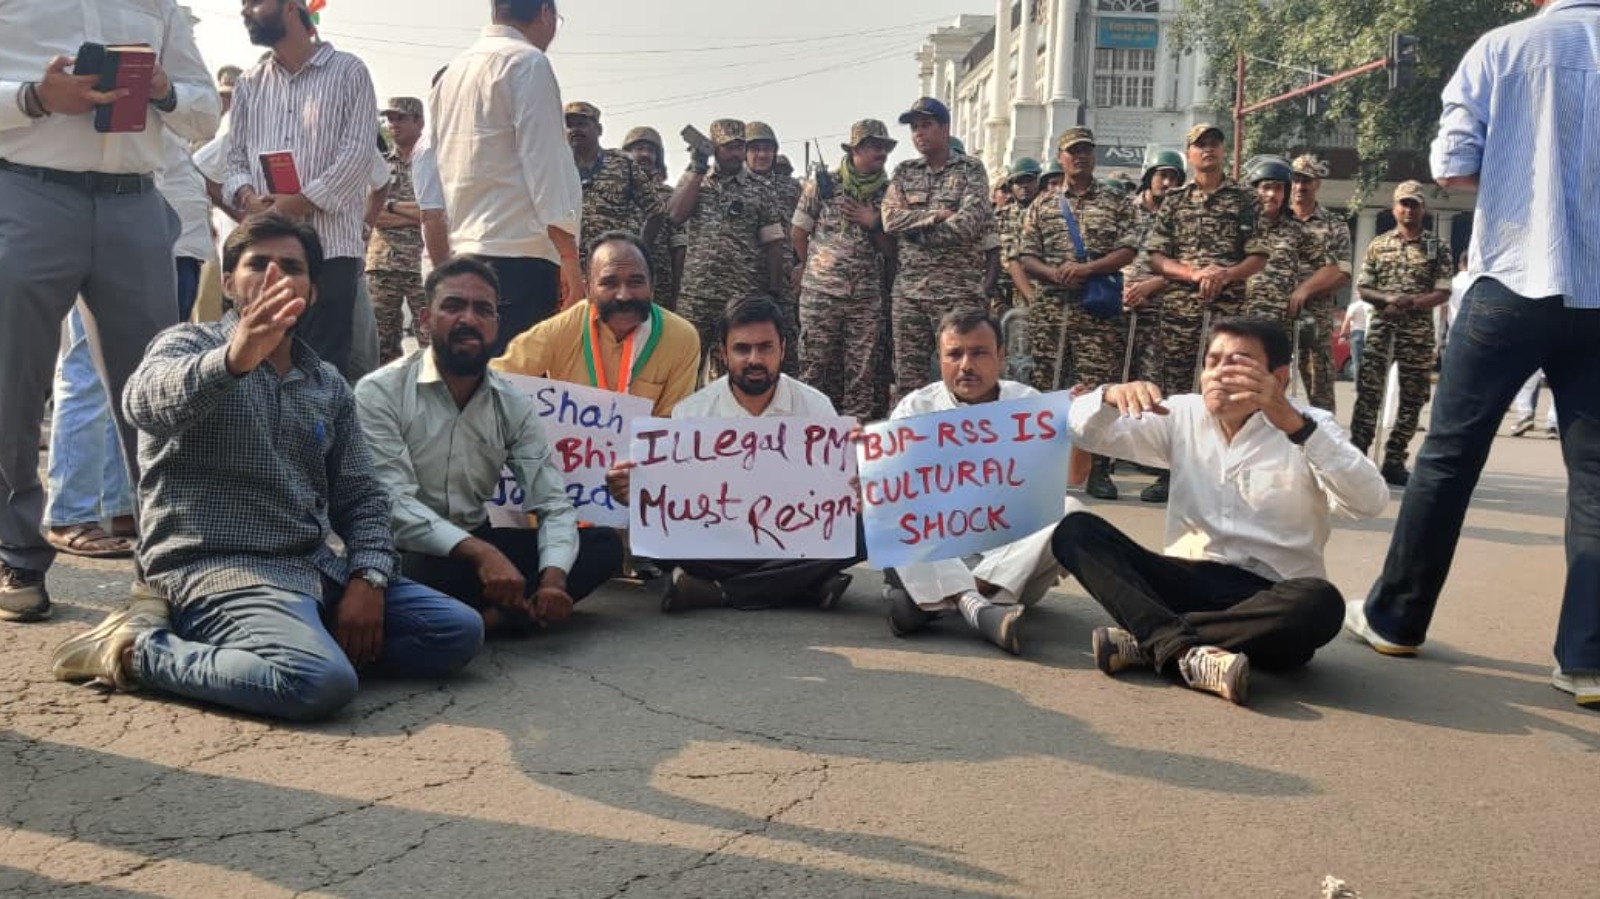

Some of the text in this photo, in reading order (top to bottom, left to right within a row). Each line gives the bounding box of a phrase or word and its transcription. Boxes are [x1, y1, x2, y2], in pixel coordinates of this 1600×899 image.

[1105, 146, 1145, 158] ASI
[537, 388, 623, 434] Shah
[937, 419, 998, 447] RSS
[1010, 411, 1057, 442] IS
[555, 436, 616, 473] Bhi
[804, 425, 851, 471] PM
[865, 458, 1025, 506] CULTURAL
[640, 482, 742, 535] Must
[899, 504, 1011, 545] SHOCK
